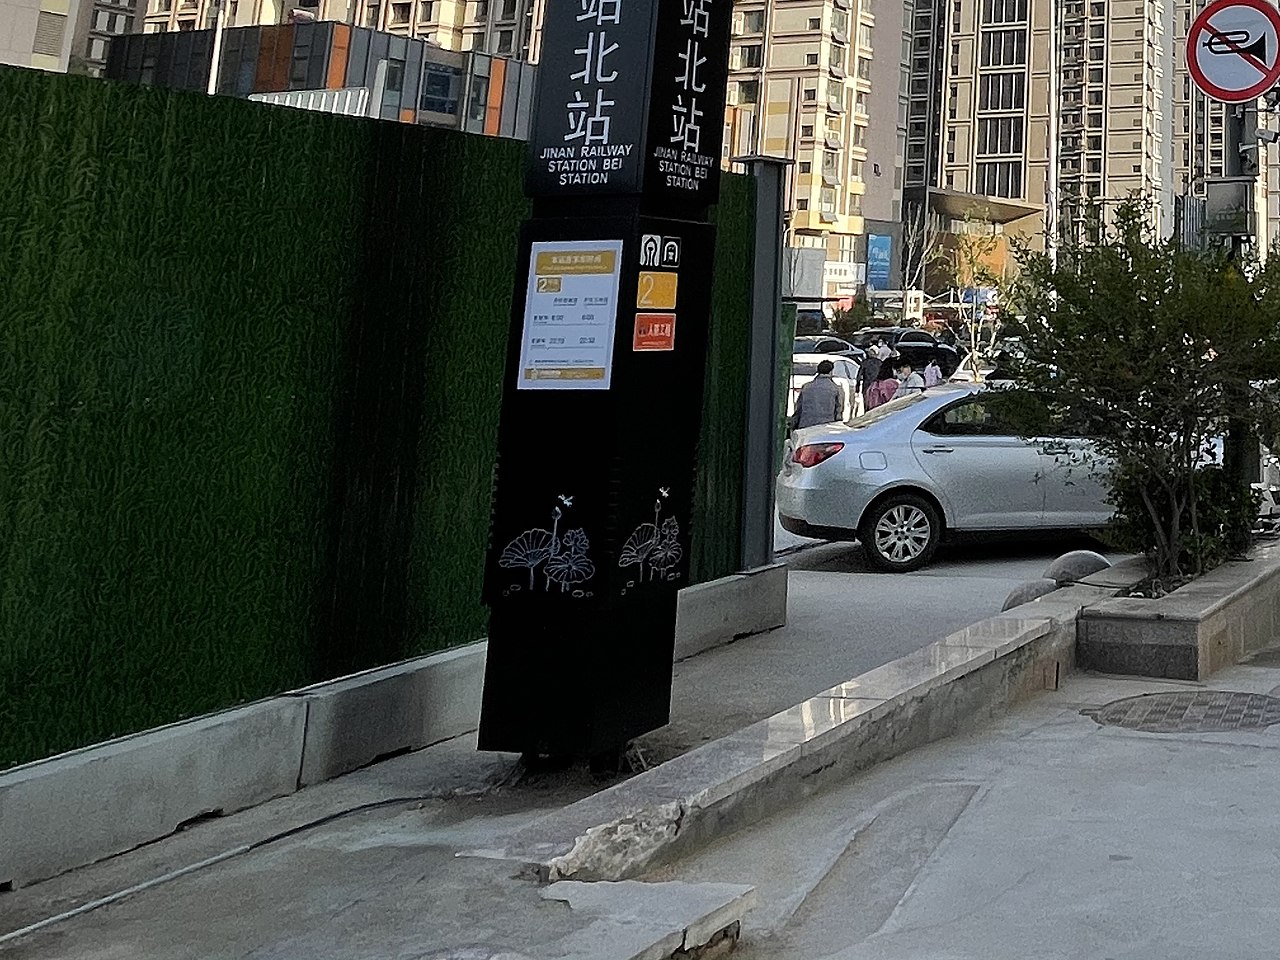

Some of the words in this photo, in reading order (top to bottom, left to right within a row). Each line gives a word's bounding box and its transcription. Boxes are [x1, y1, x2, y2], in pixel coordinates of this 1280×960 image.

[540, 147, 575, 159] JINAN
[581, 144, 633, 158] RAILWAY
[548, 160, 597, 172] STATION
[603, 158, 622, 170] BEI
[659, 160, 691, 176] STATION
[559, 172, 608, 185] STATION
[666, 175, 699, 191] STATION
[640, 275, 654, 304] 2
